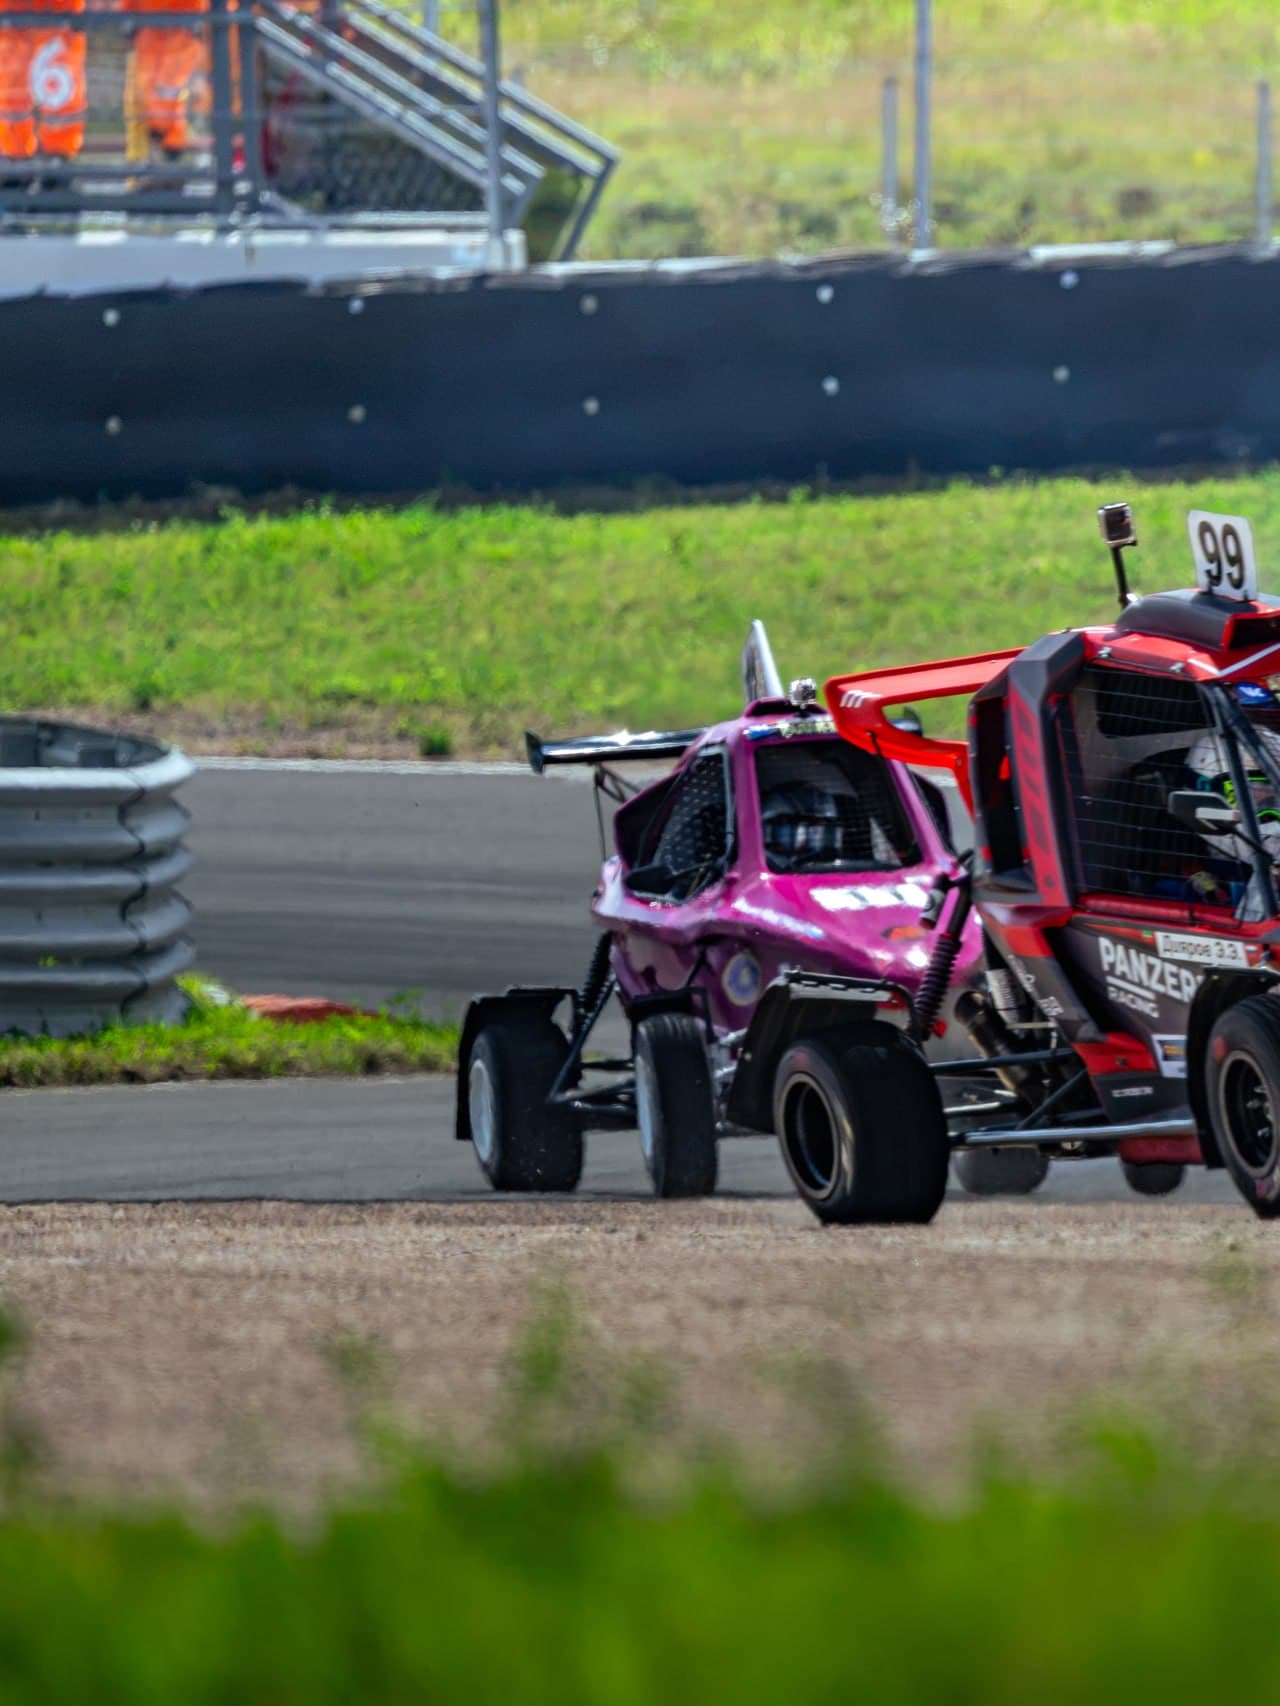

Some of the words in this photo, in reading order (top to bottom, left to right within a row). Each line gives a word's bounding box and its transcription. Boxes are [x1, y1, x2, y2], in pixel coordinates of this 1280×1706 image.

[31, 37, 75, 110] 6
[1198, 520, 1245, 590] 99
[1099, 936, 1204, 1002] PANZER
